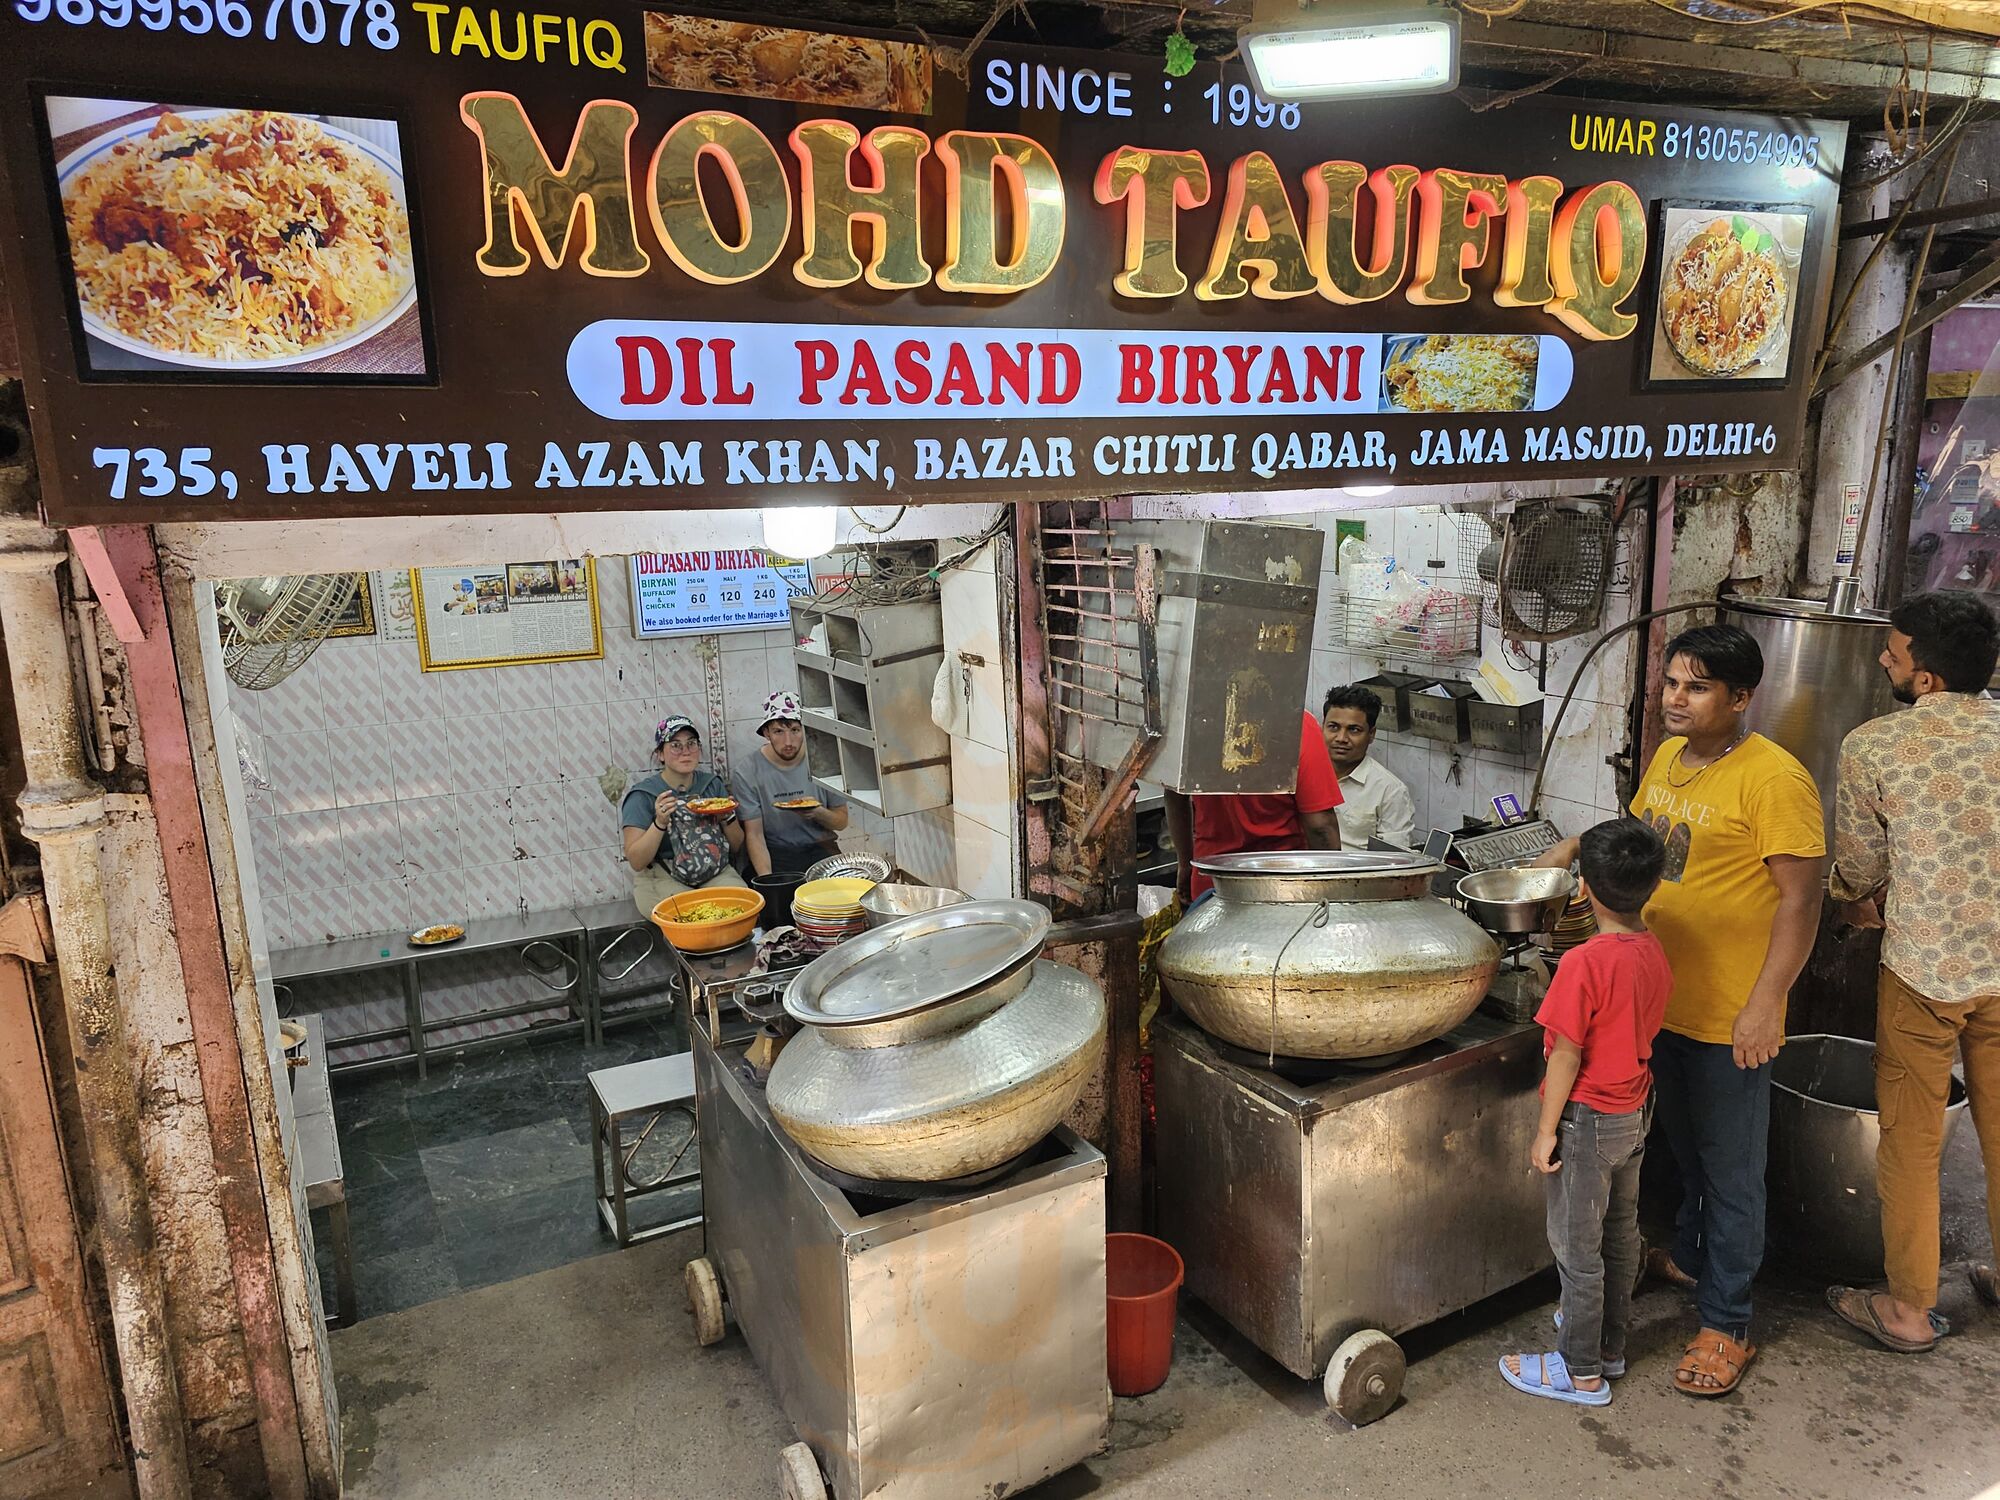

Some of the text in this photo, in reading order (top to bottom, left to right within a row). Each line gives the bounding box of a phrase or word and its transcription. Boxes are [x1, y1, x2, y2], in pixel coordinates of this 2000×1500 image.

[412, 2, 626, 74] TAUFIQ
[986, 59, 1133, 117] SINCE
[1203, 82, 1301, 130] 1998
[1569, 113, 1820, 168] UMAR 8130554995
[459, 91, 1648, 340] MOHD TAUFIQ
[615, 336, 1363, 405] DIL PASAND BIRYANI
[93, 422, 1777, 499] 735, HAVELI AZAM KHAN, BAZAR CHITLI QABAR, JAMA MASJID, DELHI-6
[640, 549, 765, 574] DILPASAND BIRYANI
[641, 577, 677, 588] BIRYANI
[642, 590, 677, 598] BUFFALOW
[754, 588, 776, 600] 240
[787, 587, 808, 598] 260
[691, 594, 706, 604] 60
[720, 590, 741, 601] 120
[645, 617, 656, 627] We
[658, 617, 674, 626] also
[676, 614, 700, 625] booked
[702, 613, 721, 623] order
[723, 612, 733, 621] for
[735, 611, 746, 620] the
[748, 609, 778, 621] Marriage
[779, 609, 785, 617] &
[1466, 827, 1559, 862] CASH COUNTER
